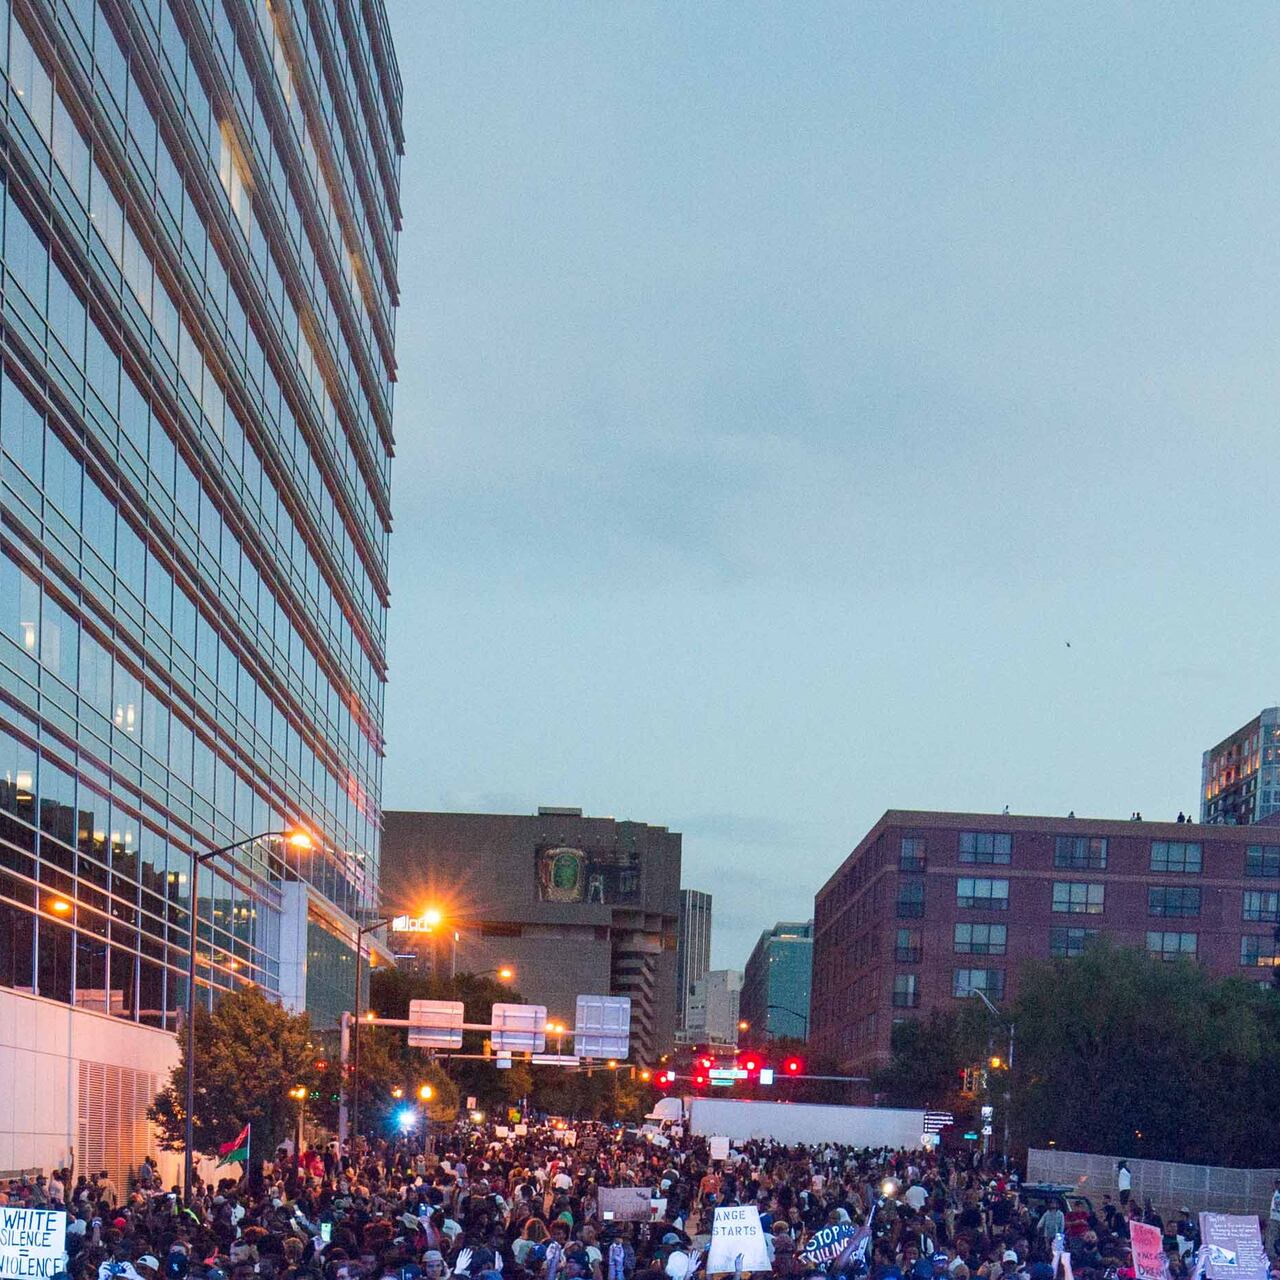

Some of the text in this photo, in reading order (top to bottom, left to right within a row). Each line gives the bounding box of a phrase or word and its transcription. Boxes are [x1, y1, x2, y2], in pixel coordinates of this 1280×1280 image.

[3, 1208, 58, 1231] WHITE
[0, 1228, 52, 1247] SILENCE
[711, 1225, 757, 1237] STARTS
[806, 1225, 840, 1251] STOP
